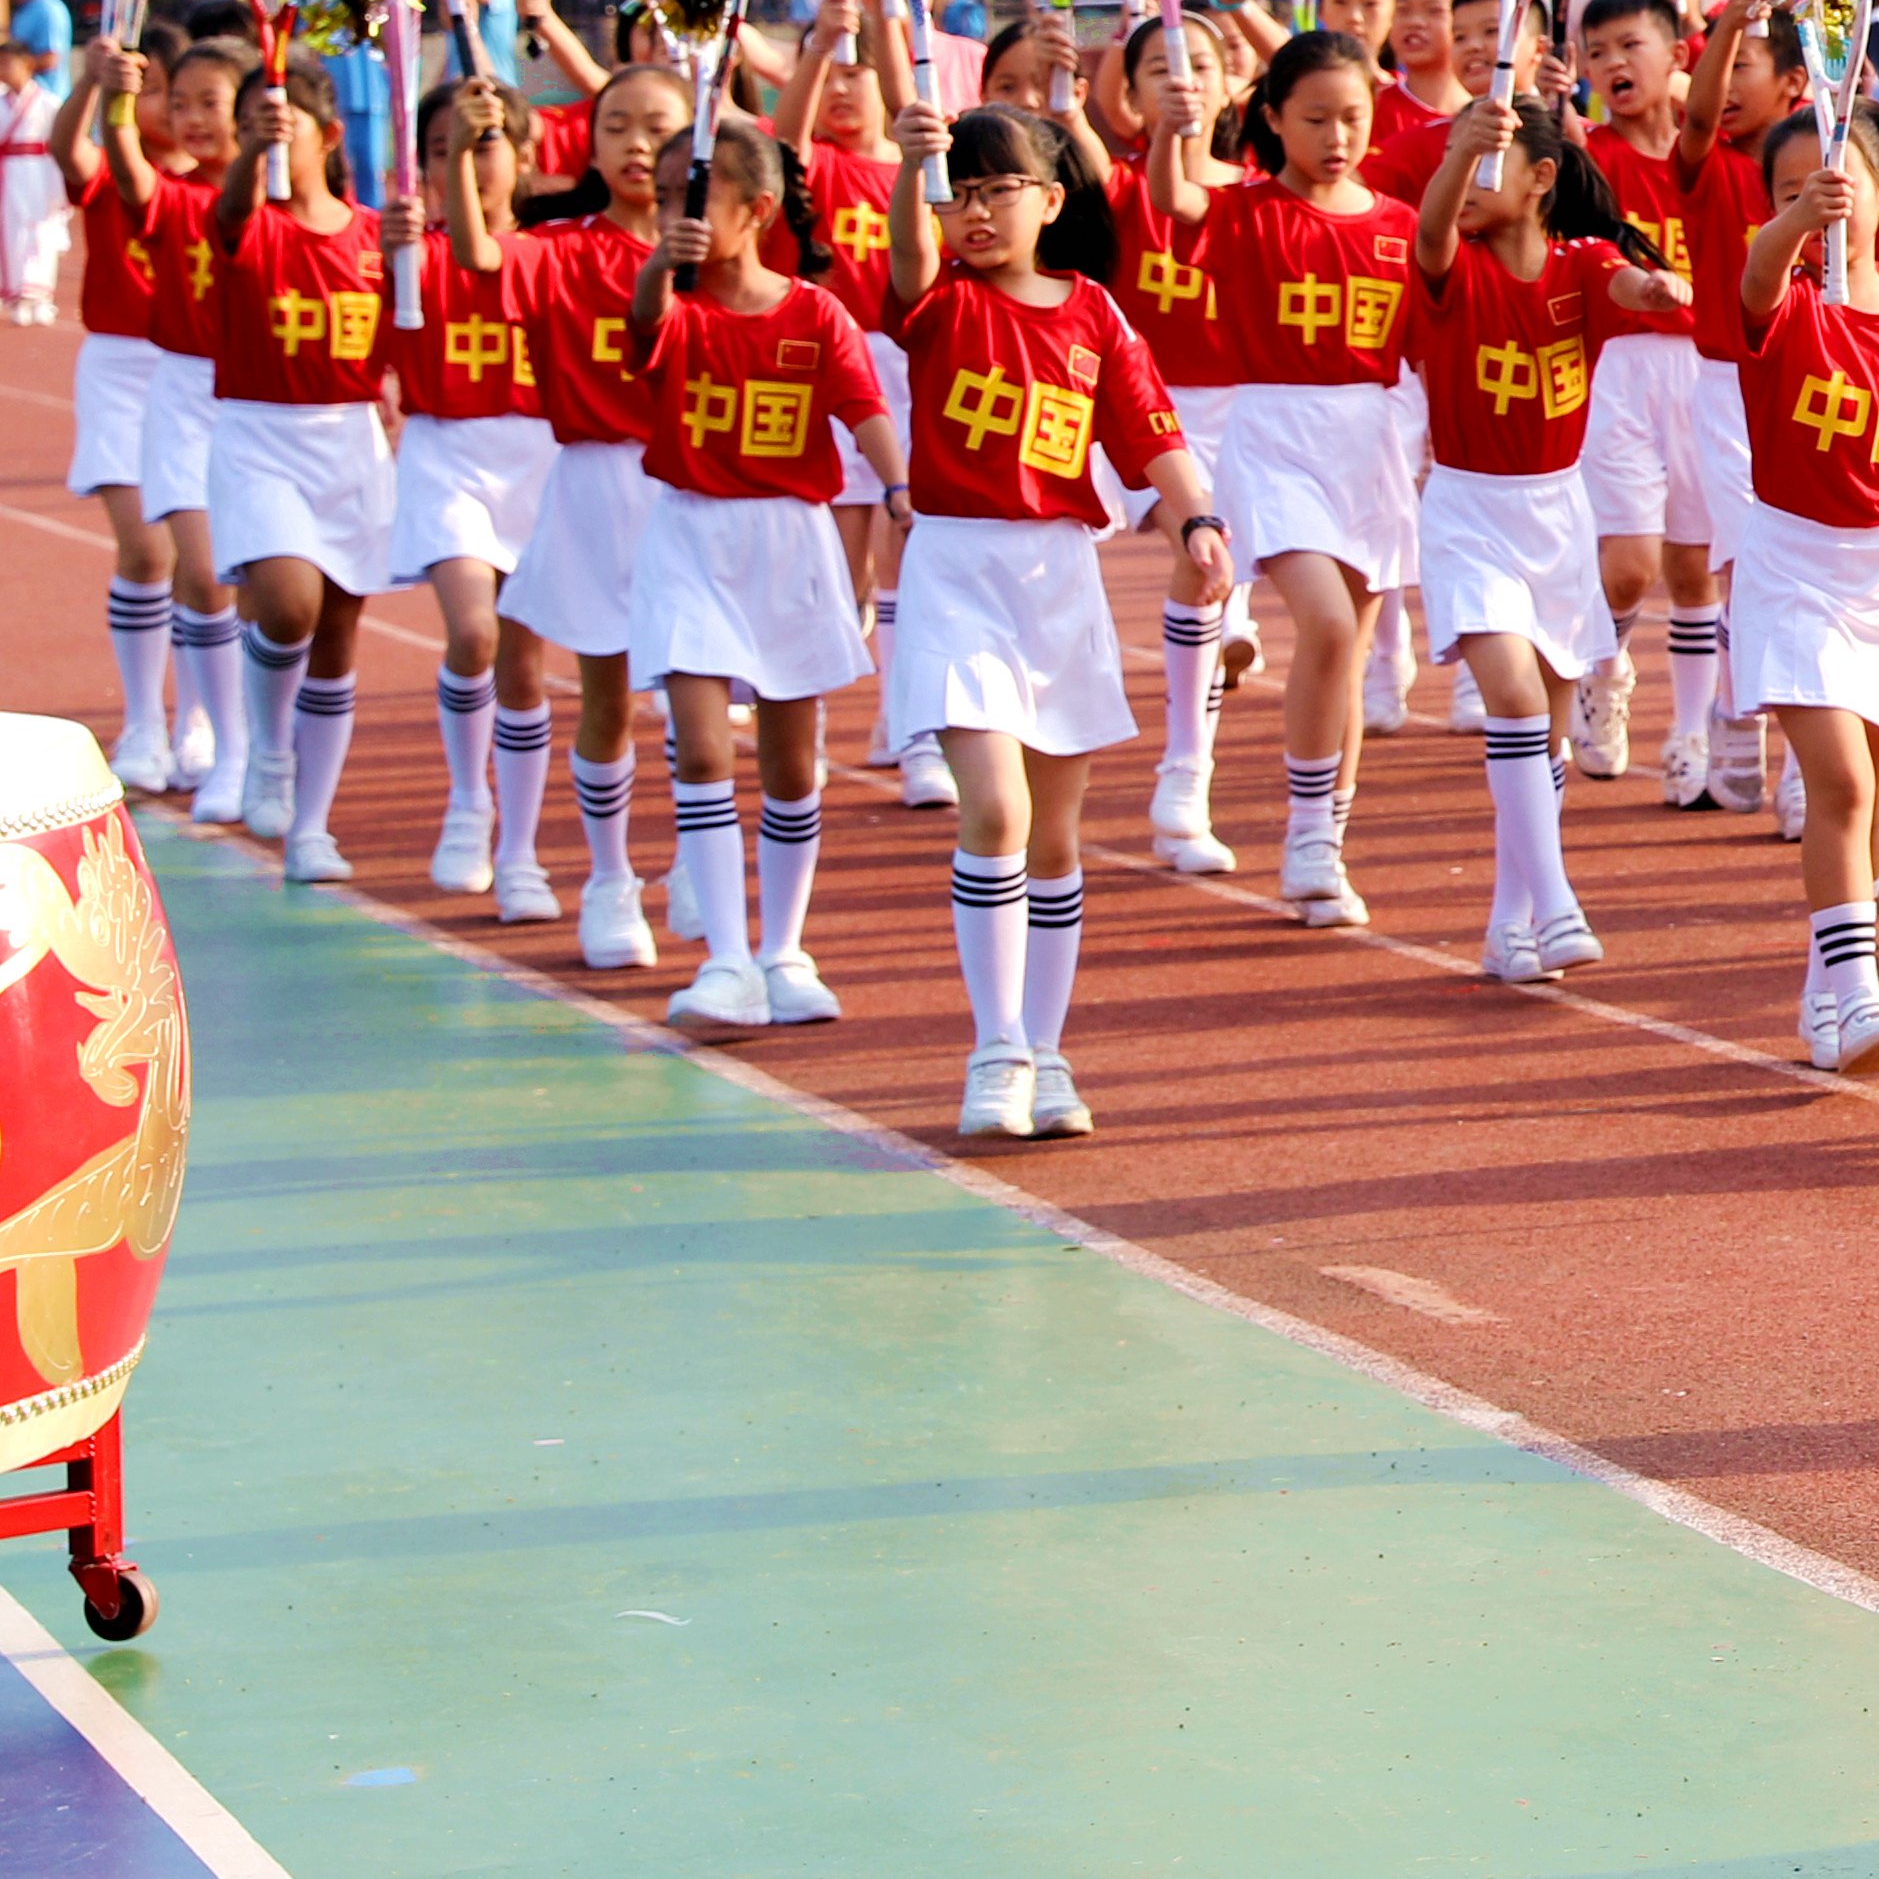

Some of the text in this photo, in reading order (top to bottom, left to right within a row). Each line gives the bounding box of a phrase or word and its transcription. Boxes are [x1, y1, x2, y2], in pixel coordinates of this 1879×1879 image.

[269, 288, 381, 361] 中国
[1278, 273, 1405, 350] 中国
[681, 371, 813, 458] 中国
[1476, 333, 1589, 420] 中国
[943, 366, 1095, 480] 中国
